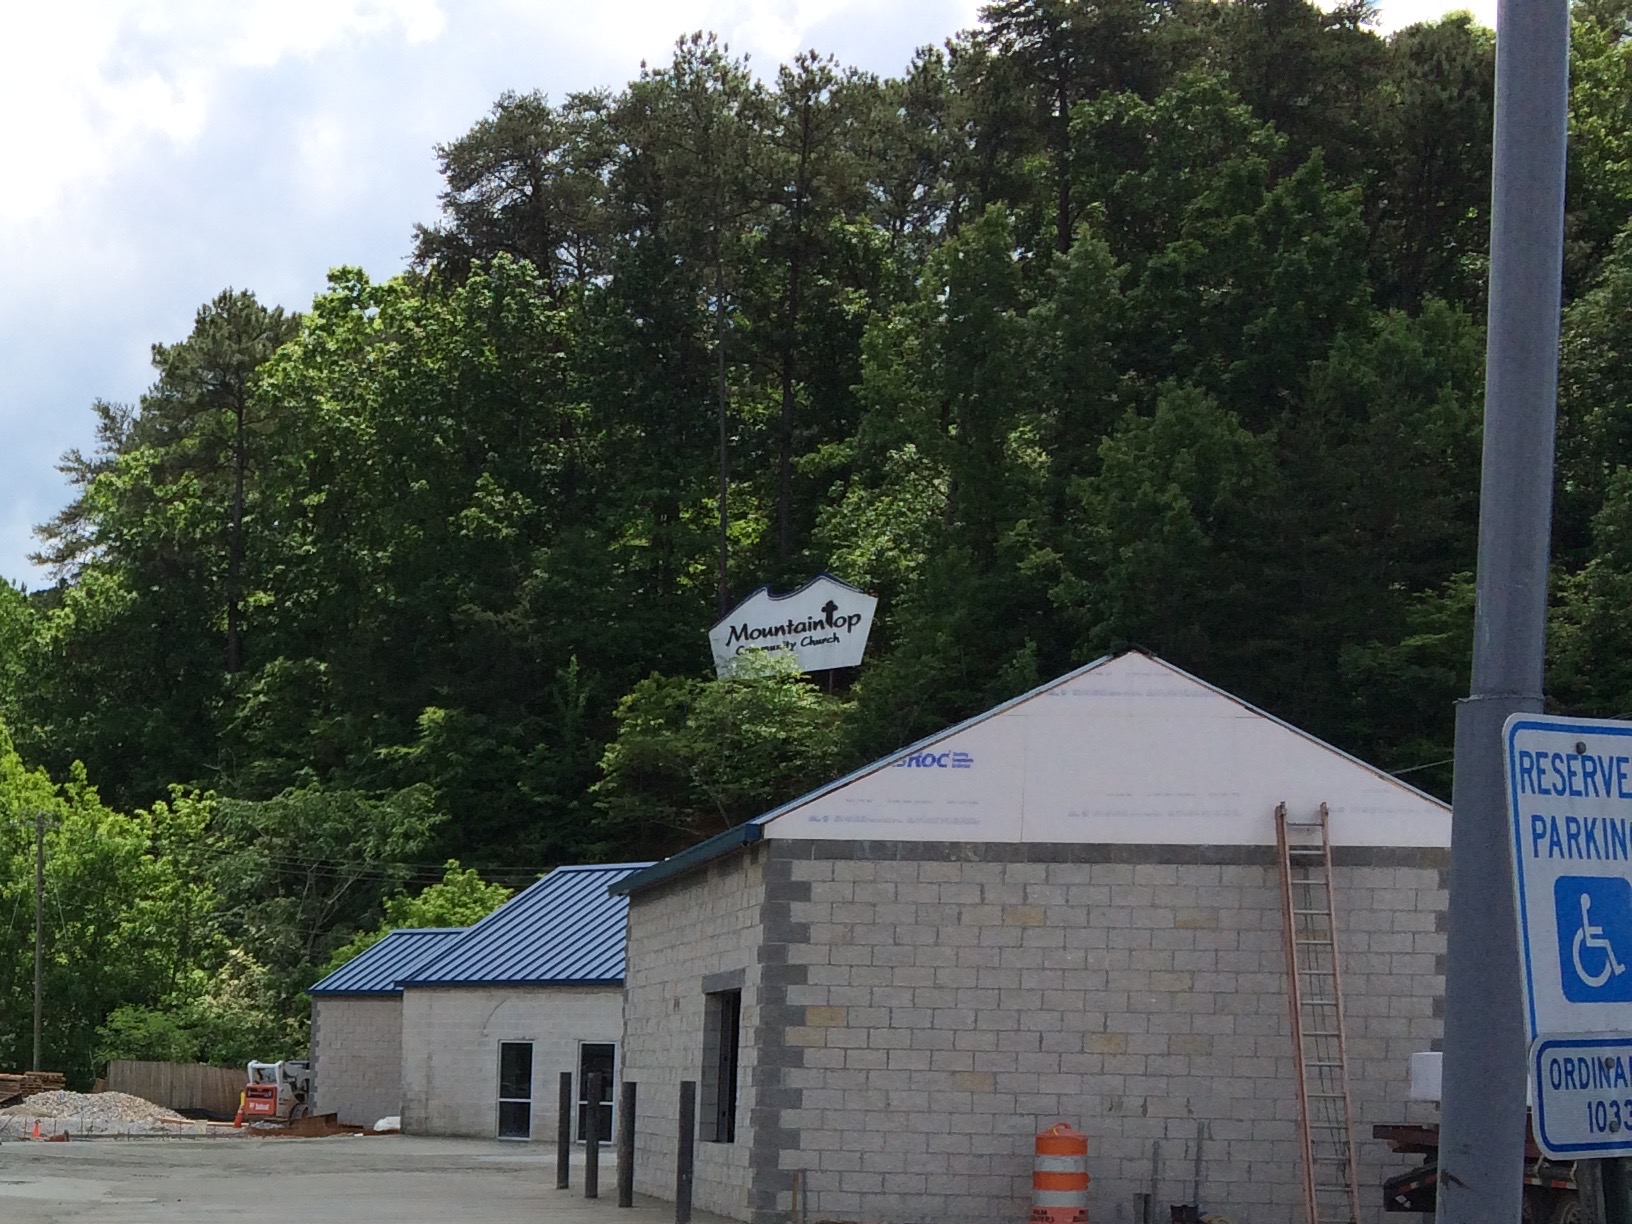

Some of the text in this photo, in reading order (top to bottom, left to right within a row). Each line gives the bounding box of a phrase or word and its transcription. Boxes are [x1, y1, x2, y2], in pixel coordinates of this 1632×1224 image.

[801, 632, 840, 647] Church
[1519, 750, 1632, 799] RESERVE
[1531, 814, 1632, 861] PARKIN
[1550, 1056, 1632, 1090] ORDINA
